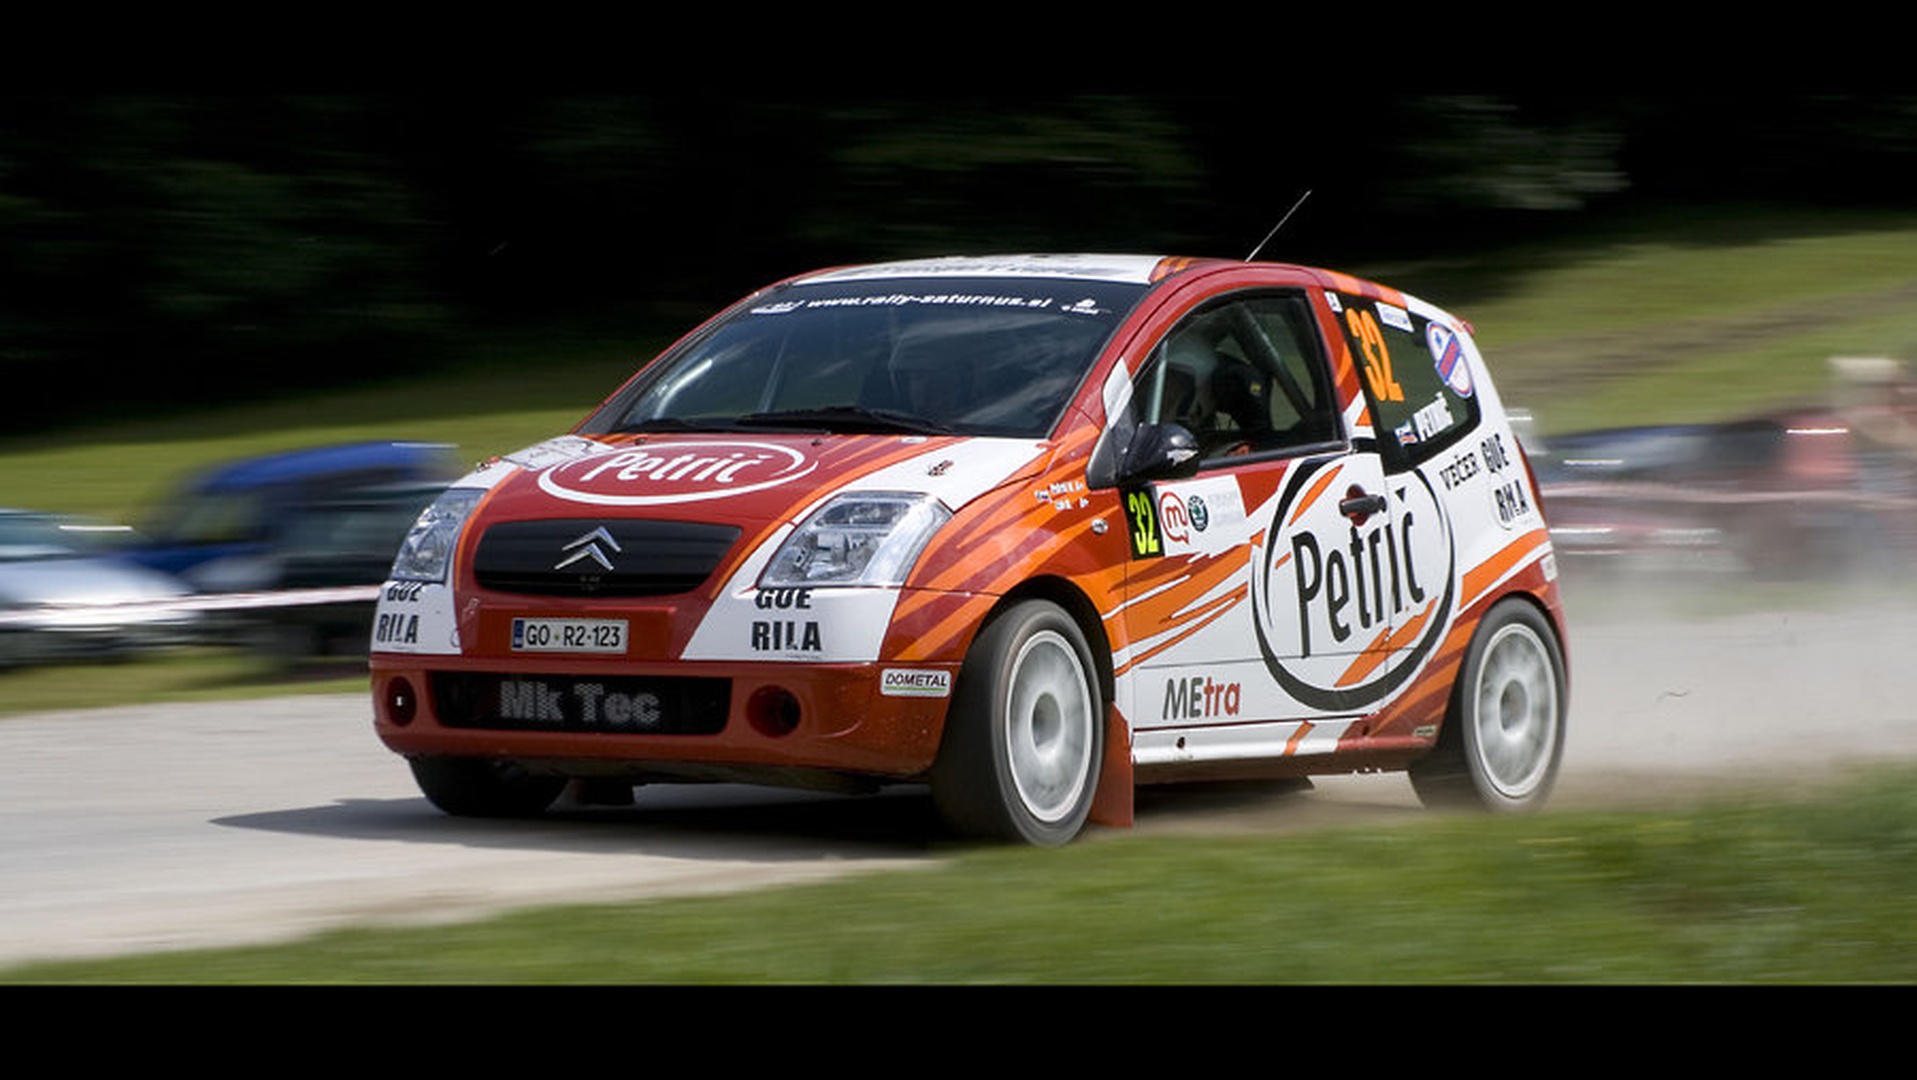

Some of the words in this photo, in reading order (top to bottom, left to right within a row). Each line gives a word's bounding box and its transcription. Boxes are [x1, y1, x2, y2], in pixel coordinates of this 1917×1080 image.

[1345, 308, 1405, 402] 32
[578, 452, 773, 483] Petrič
[1128, 492, 1159, 555] 32
[1291, 486, 1425, 659] Petrič
[754, 587, 814, 609] GUE
[526, 624, 550, 646] GO
[885, 673, 948, 687] DOMETAL
[1162, 676, 1241, 720] METra
[501, 681, 564, 720] Mk
[573, 683, 661, 725] Tec
